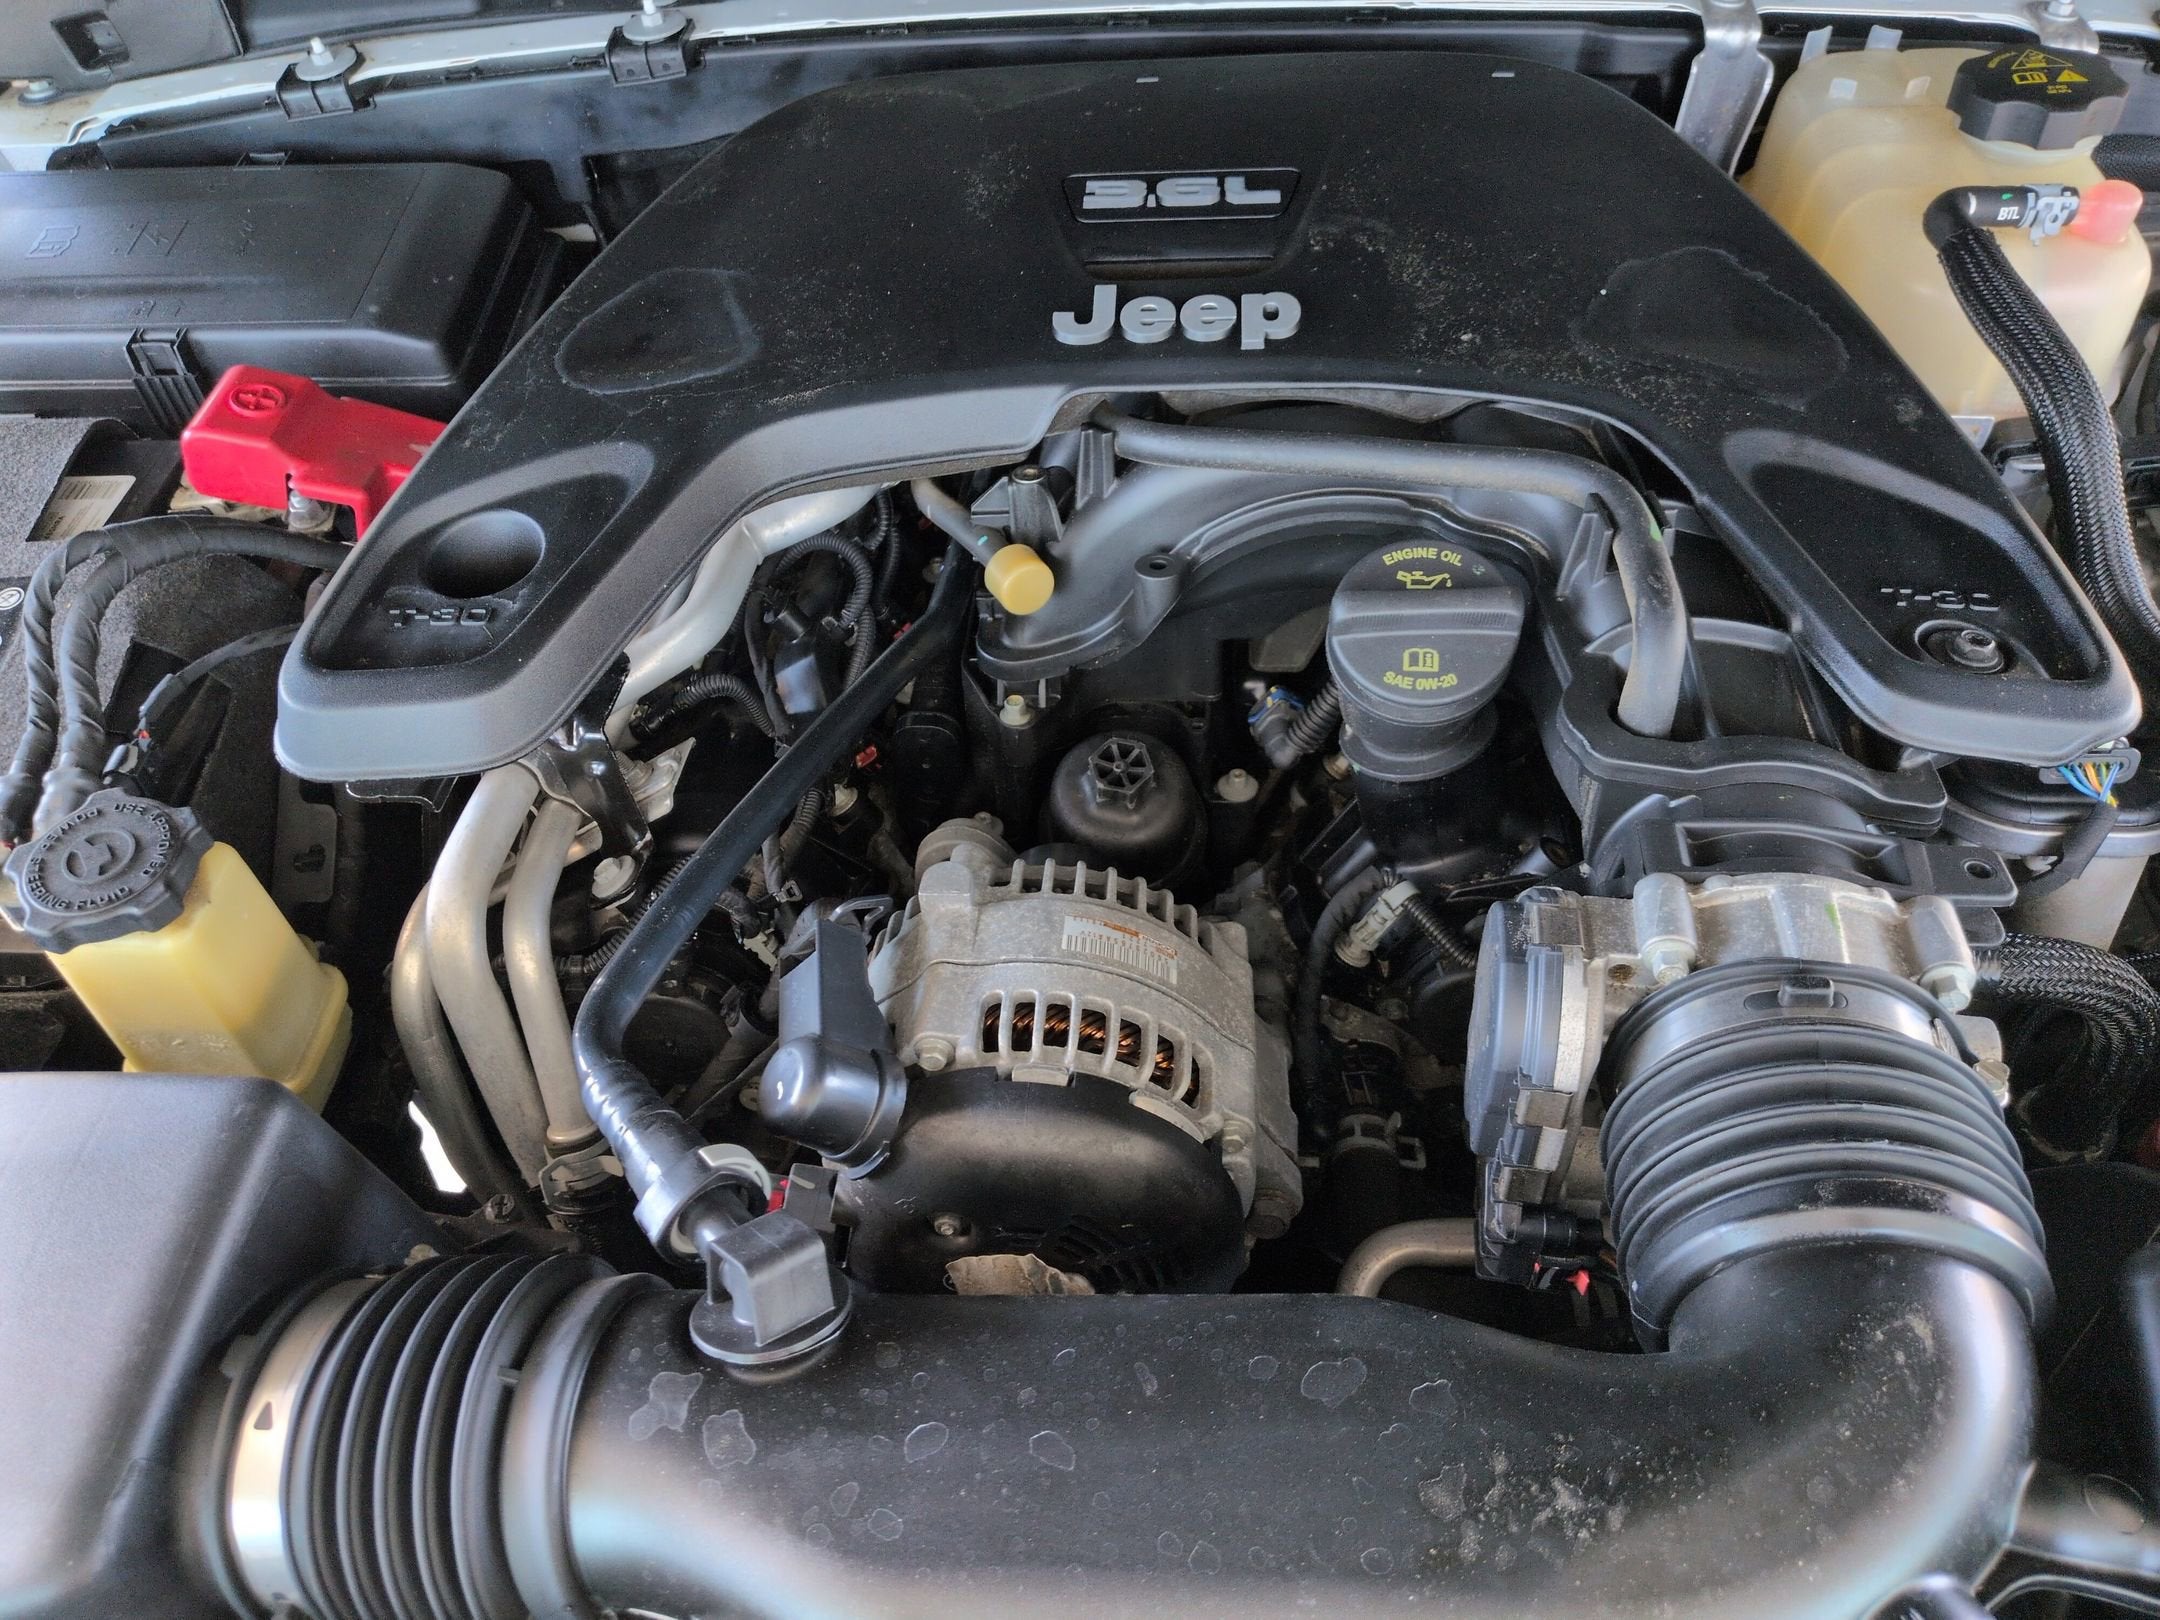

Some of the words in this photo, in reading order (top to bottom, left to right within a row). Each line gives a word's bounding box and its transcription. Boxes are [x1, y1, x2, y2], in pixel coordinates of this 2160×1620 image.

[1082, 176, 1282, 210] 3.6L
[1997, 206, 2020, 220] BTL
[1052, 284, 1302, 350] Jeep
[1382, 547, 1439, 566] ENGINE
[1440, 549, 1463, 567] OIL
[1383, 671, 1413, 689] SAE
[1415, 673, 1458, 690] 0W-20
[41, 807, 101, 850] POWER
[114, 803, 148, 814] USE
[141, 809, 171, 877] APPROVED
[28, 856, 71, 909] STEERING
[74, 885, 132, 910] FLUID
